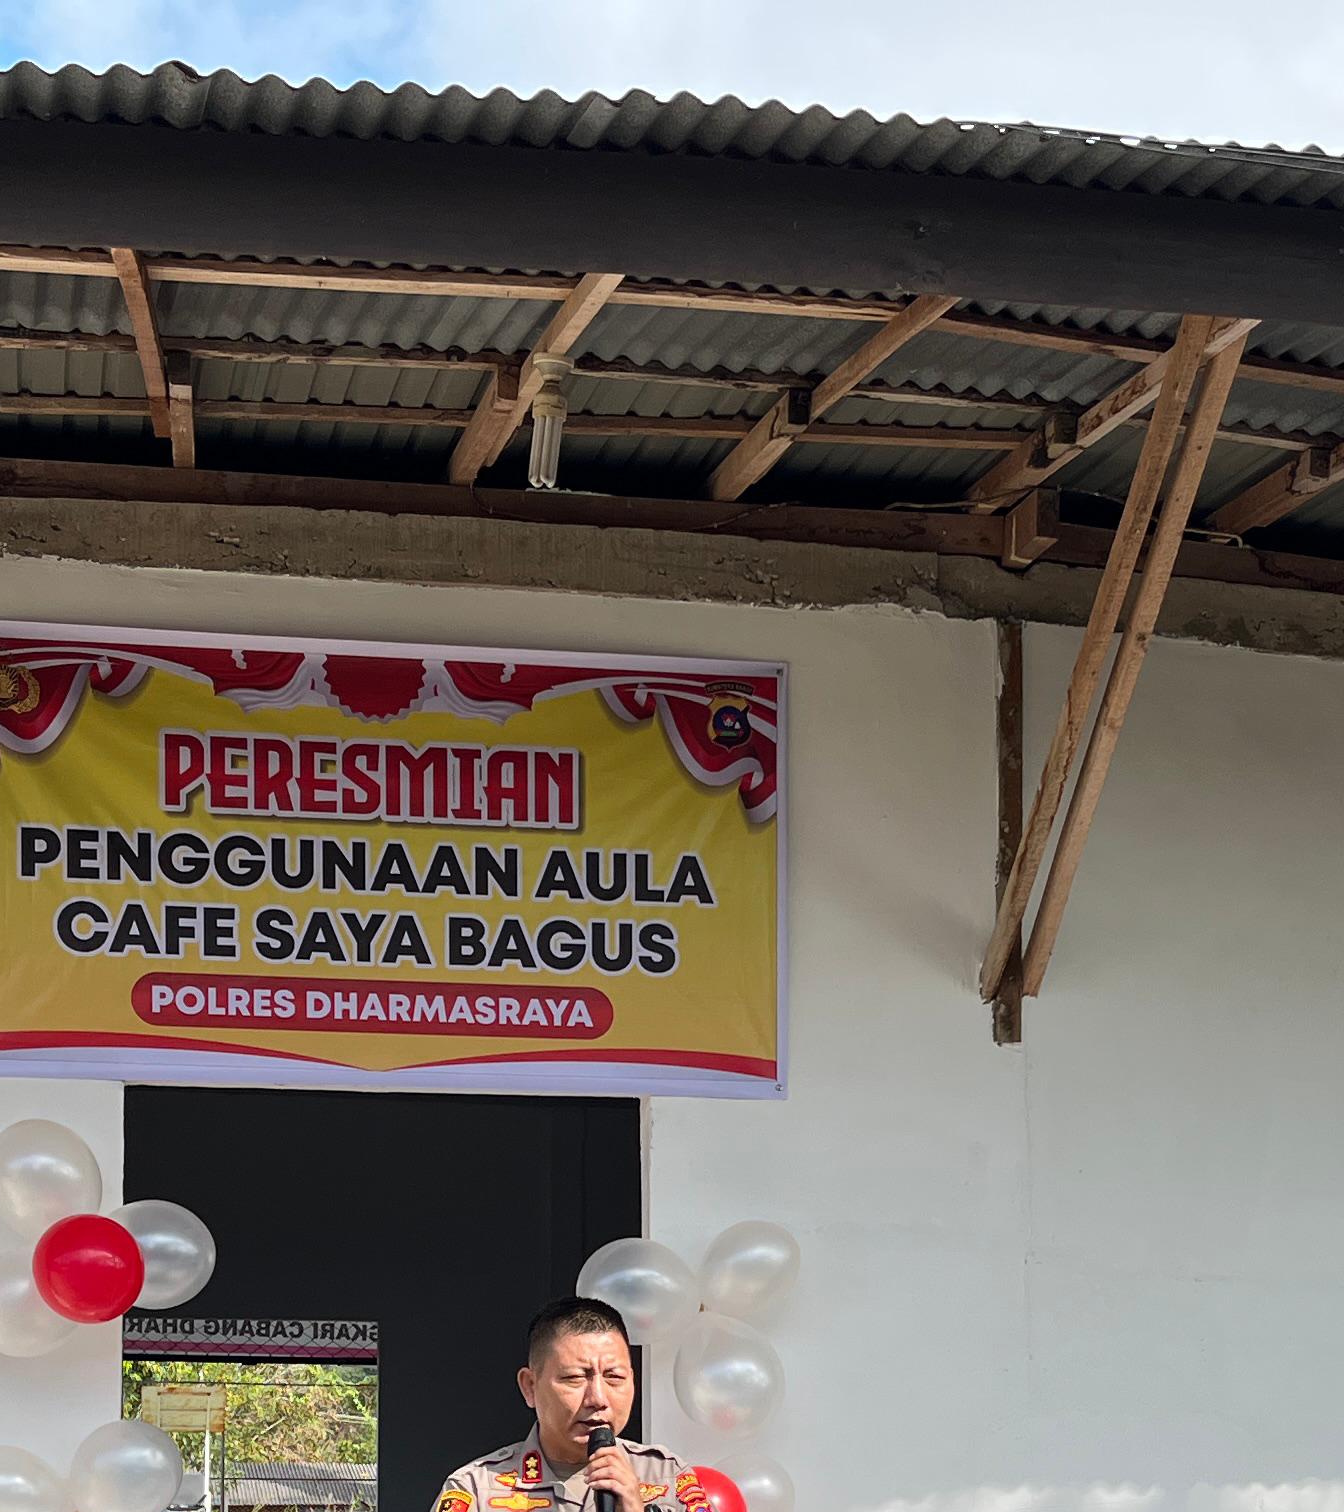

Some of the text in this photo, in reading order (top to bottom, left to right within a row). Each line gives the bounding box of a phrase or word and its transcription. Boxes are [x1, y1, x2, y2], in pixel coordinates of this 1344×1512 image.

[164, 733, 574, 824] PERESMIAN
[21, 828, 712, 904] PENGGUNAAN AULA
[58, 902, 676, 974] CAFE SAYA BAGUS
[151, 985, 593, 1027] POLRES DHARMASRAYA
